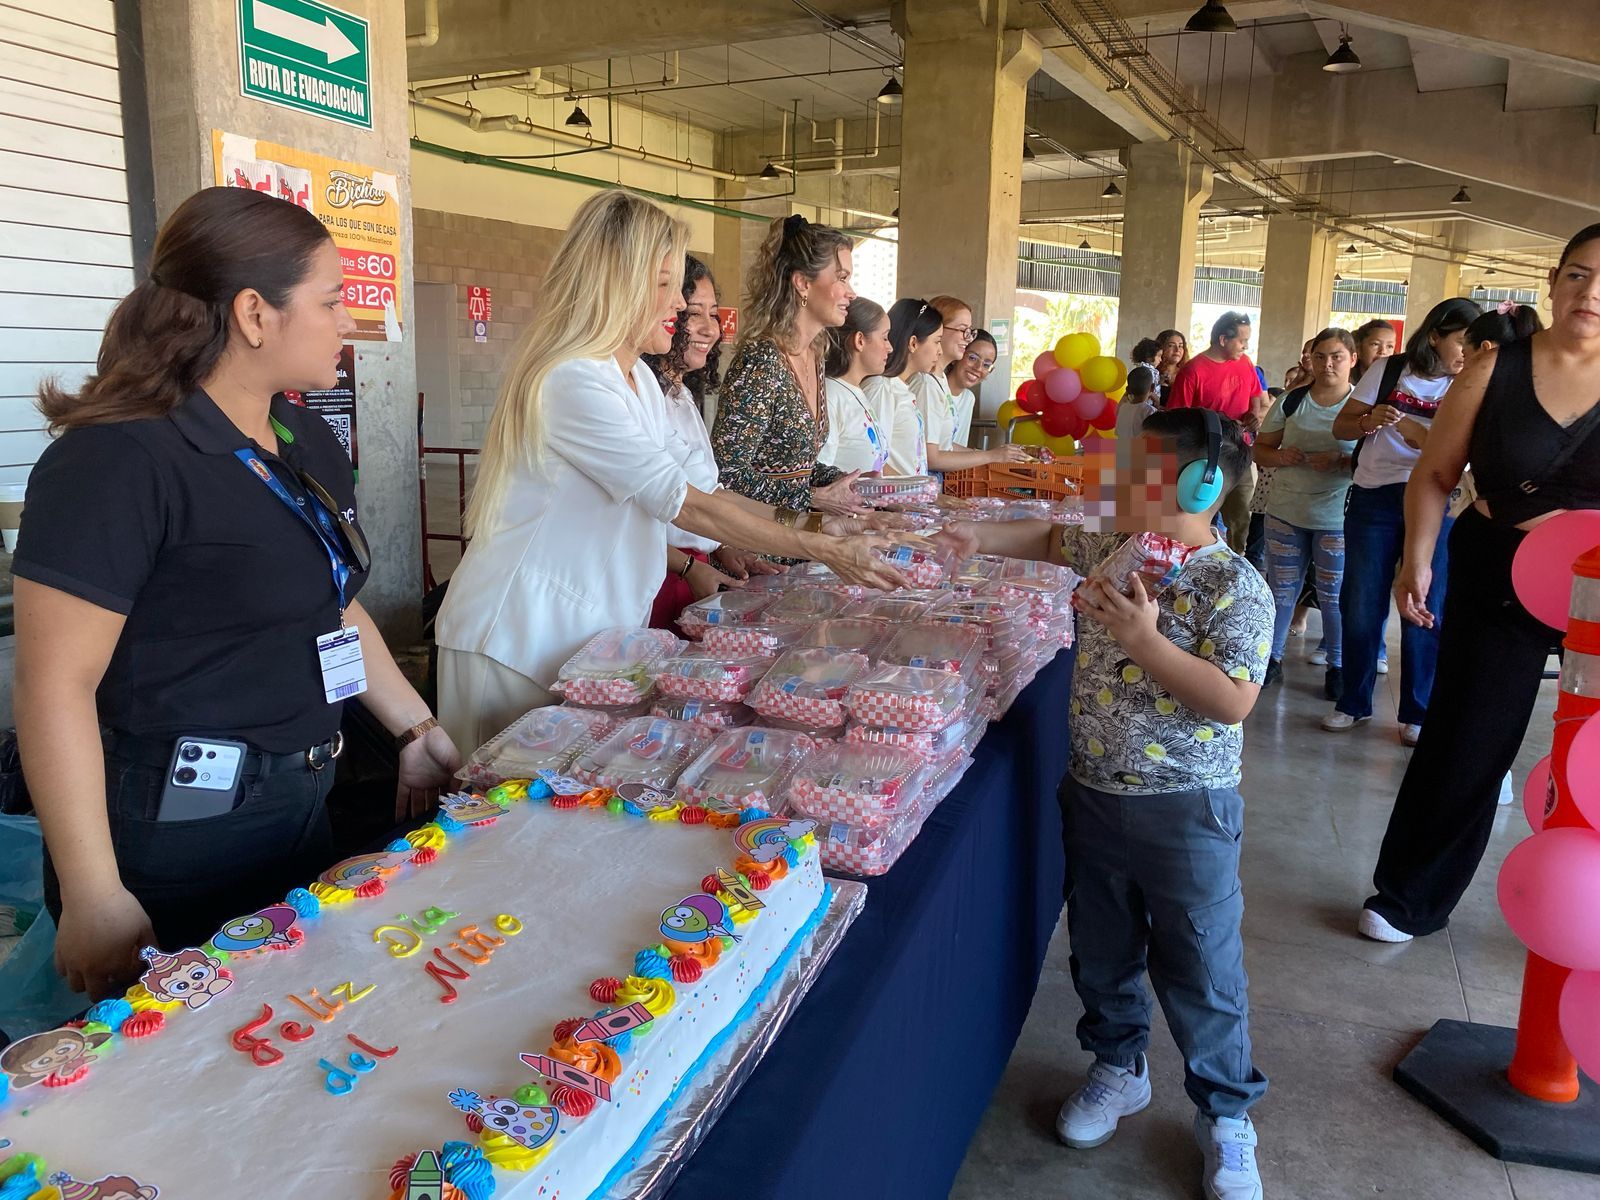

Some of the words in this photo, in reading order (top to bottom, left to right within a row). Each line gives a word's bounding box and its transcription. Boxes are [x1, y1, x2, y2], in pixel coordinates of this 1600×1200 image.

[249, 57, 281, 93] RUTA
[282, 67, 298, 98] DE
[299, 72, 365, 117] EVACUACIÓN
[319, 213, 335, 226] PARA
[336, 217, 348, 228] LOS
[349, 219, 361, 230] QUE
[363, 221, 374, 233] SON
[376, 223, 382, 234] DE
[383, 225, 397, 237] CASA
[357, 255, 393, 277] $60
[347, 284, 393, 306] $120
[317, 1033, 399, 1096] del
[424, 913, 524, 1004] Niño
[232, 980, 378, 1067] Feliz
[1234, 1132, 1249, 1140] X10
